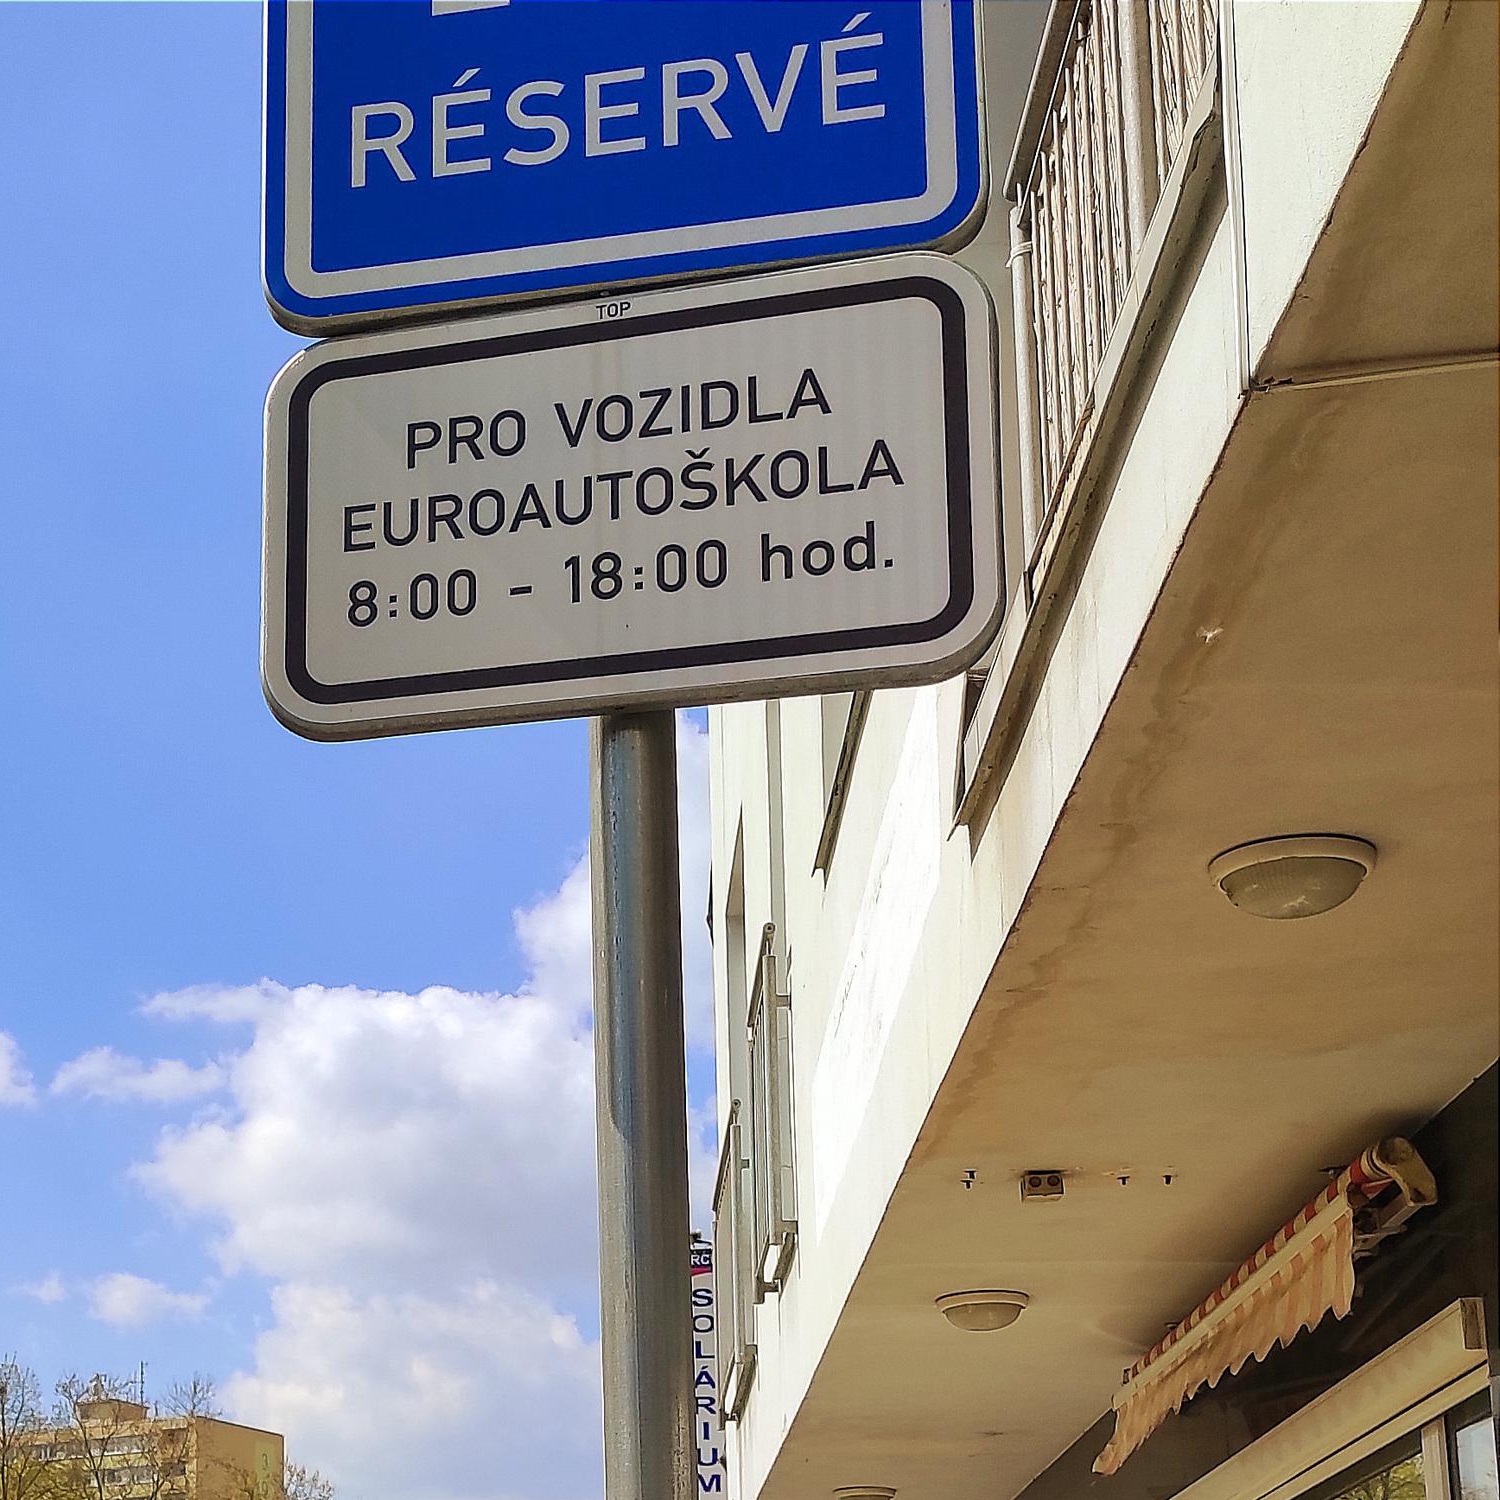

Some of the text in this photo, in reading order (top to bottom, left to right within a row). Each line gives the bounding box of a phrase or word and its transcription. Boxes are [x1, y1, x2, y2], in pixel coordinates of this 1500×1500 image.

[350, 12, 886, 188] RÉSERVÉ
[596, 301, 632, 320] TOP
[405, 368, 833, 470] PRO VOZIDLA
[343, 438, 905, 552] EUROAUTOŠKOLA
[347, 520, 894, 628] 8:00 - 18:00 hod.
[692, 1288, 722, 1493] SOLÁRIUM
